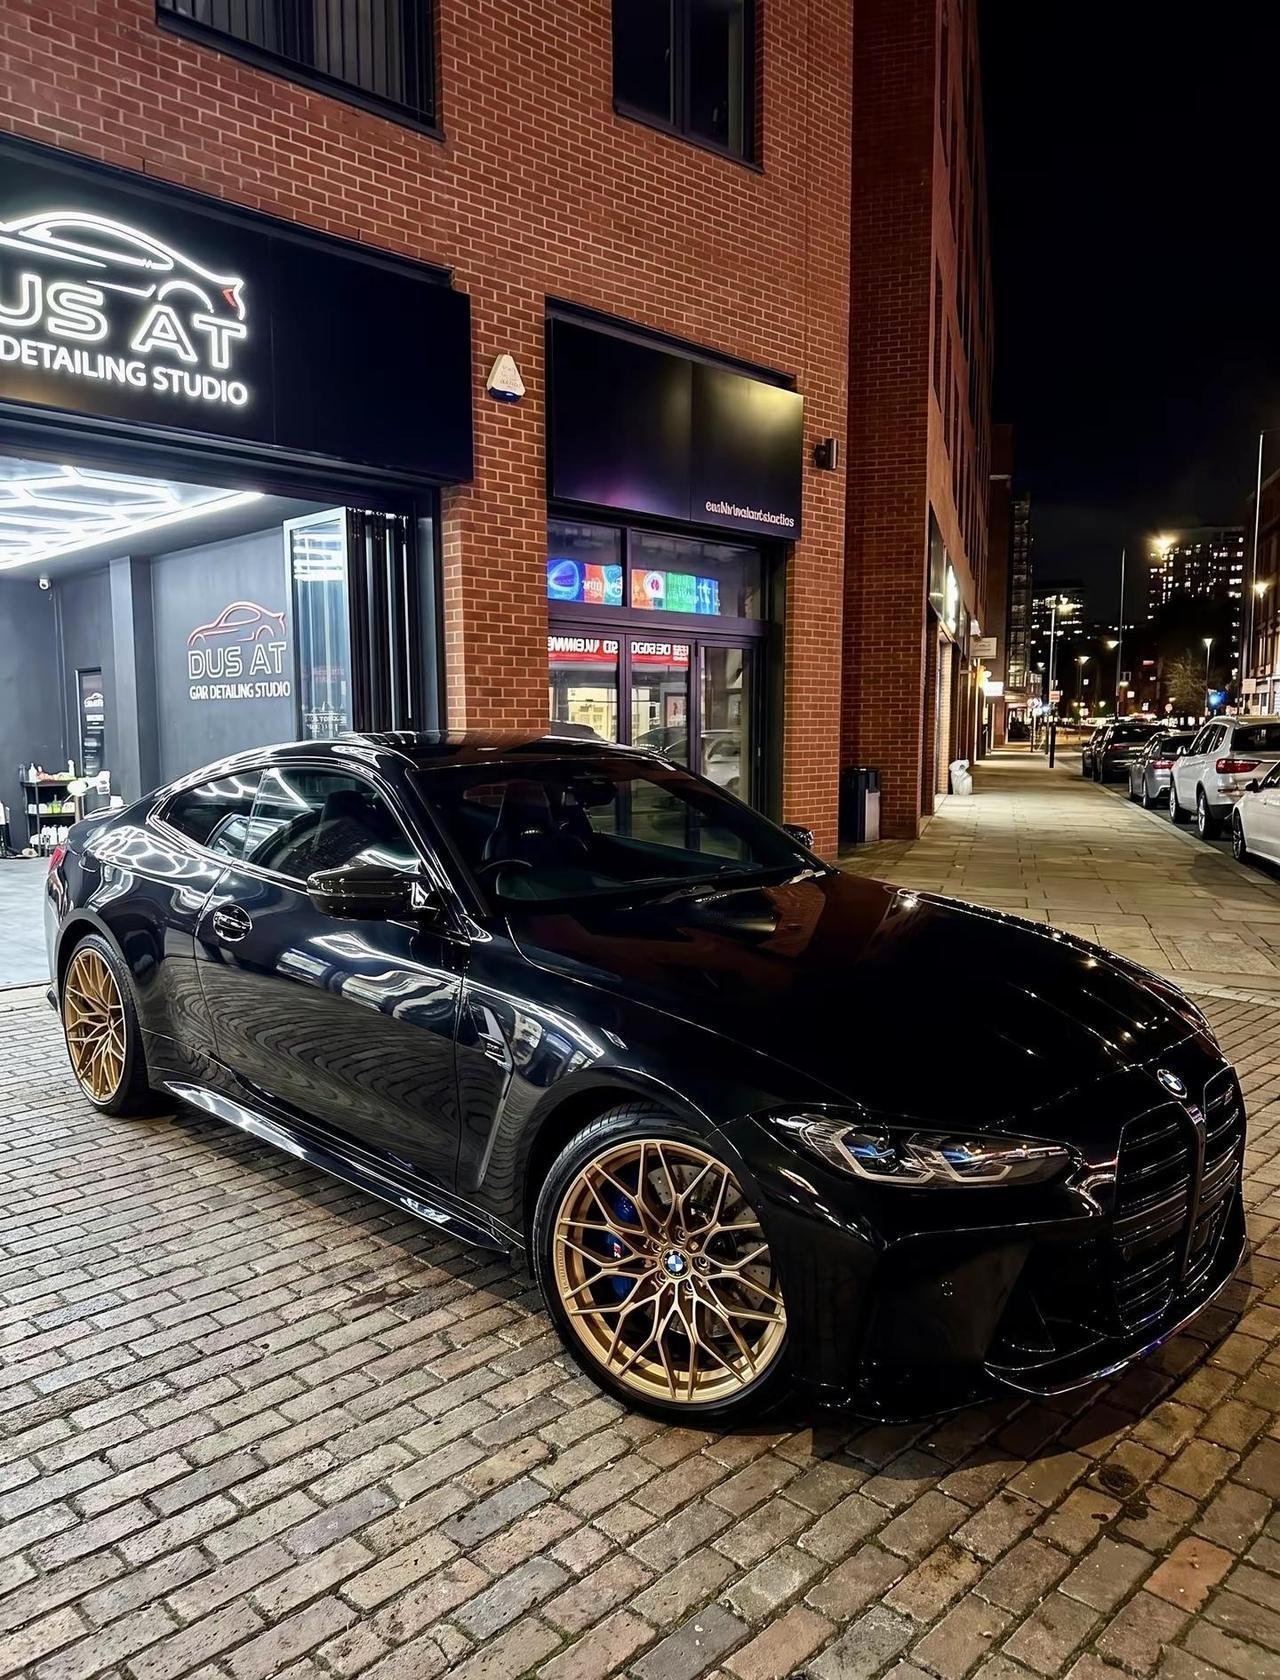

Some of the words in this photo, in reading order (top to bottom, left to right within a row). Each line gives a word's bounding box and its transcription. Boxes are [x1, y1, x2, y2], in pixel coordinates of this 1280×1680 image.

[130, 304, 247, 369] AT
[0, 334, 146, 386] DETAILING
[153, 366, 248, 405] STUDIO
[188, 646, 243, 679] DUS
[249, 641, 287, 675] AT
[209, 682, 254, 699] DETAILING
[255, 681, 291, 698] STUDIO
